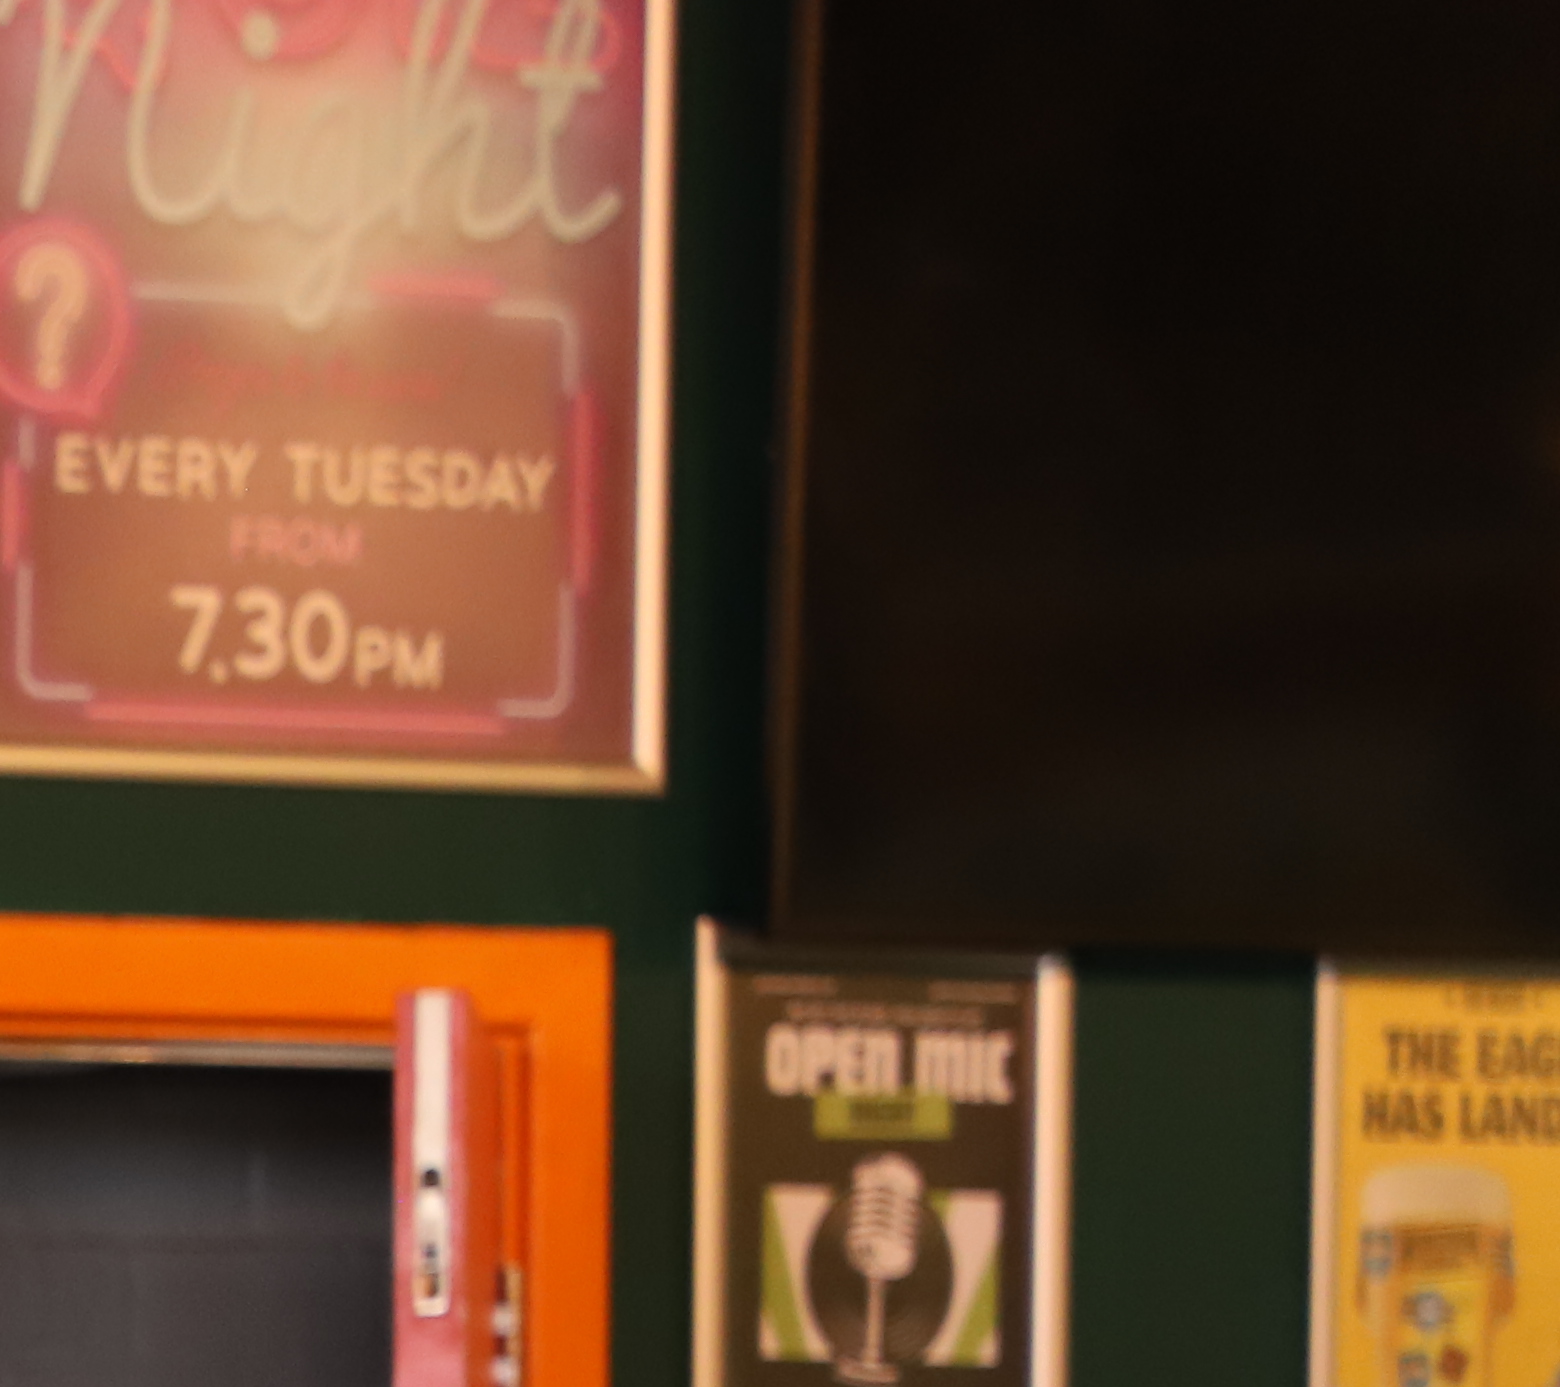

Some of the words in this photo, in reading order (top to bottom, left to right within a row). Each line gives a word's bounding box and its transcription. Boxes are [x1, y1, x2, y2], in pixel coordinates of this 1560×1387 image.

[53, 433, 257, 499] EVERY
[285, 443, 556, 511] TUESDAY
[230, 517, 364, 566] FROM
[1383, 1028, 1461, 1080] THE
[1362, 1089, 1445, 1141] HAS
